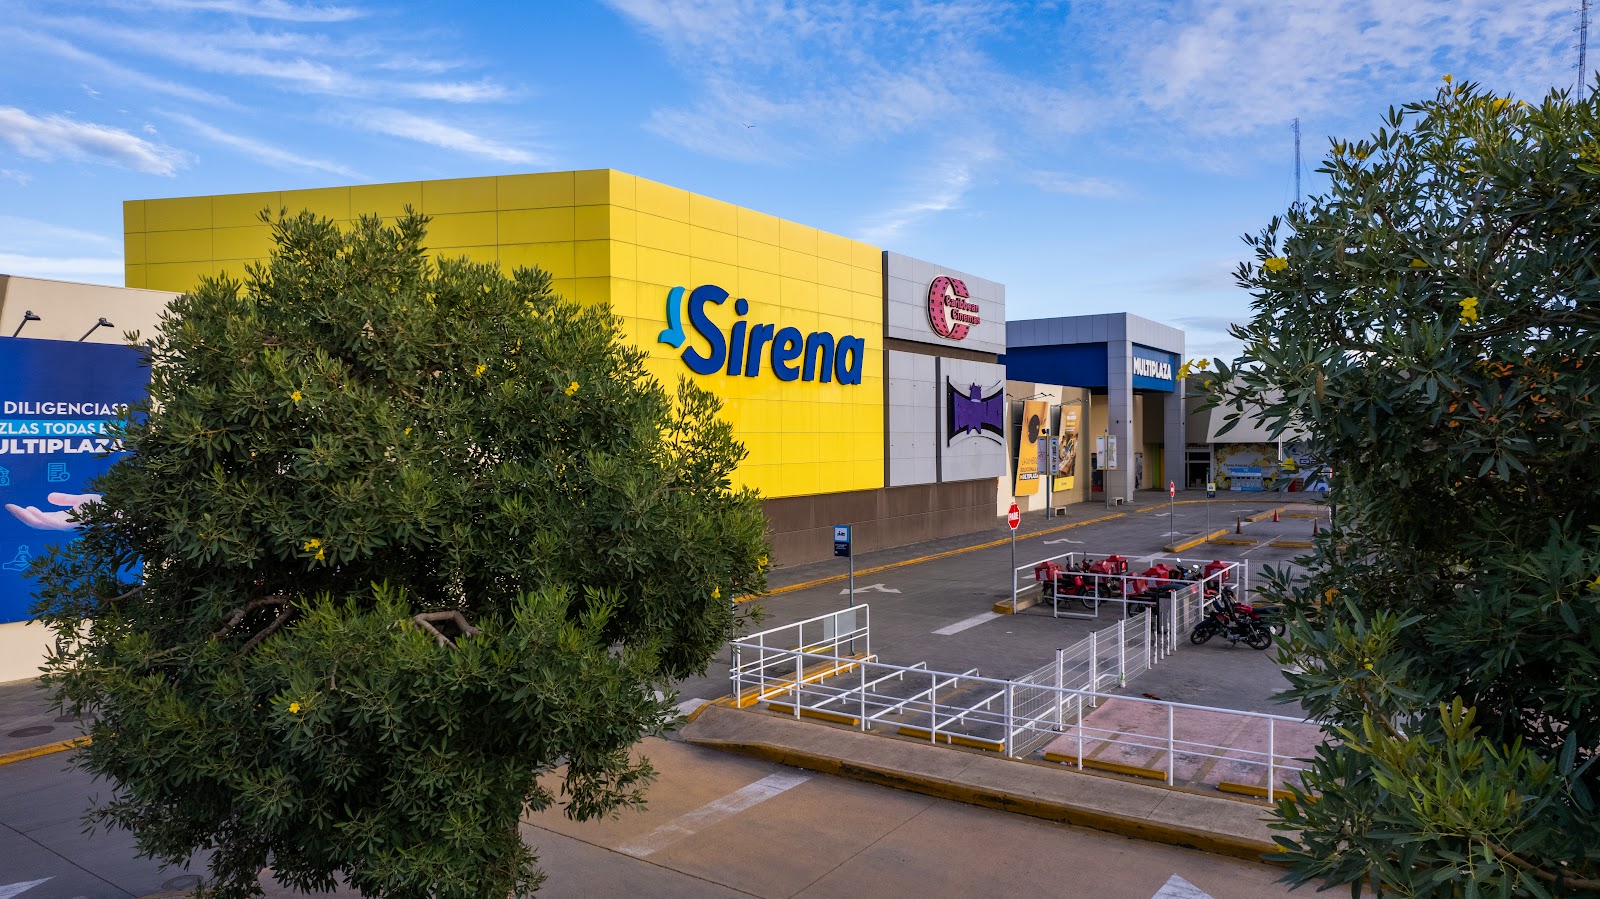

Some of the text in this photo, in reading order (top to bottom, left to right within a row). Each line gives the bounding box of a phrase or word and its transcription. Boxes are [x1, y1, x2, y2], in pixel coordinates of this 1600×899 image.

[944, 295, 979, 313] Caribbean
[951, 308, 981, 325] Cinemas
[681, 284, 865, 385] Sirena
[1133, 356, 1172, 381] MULTIPLAZA
[43, 422, 95, 435] TODAS
[1009, 511, 1019, 521] PARE
